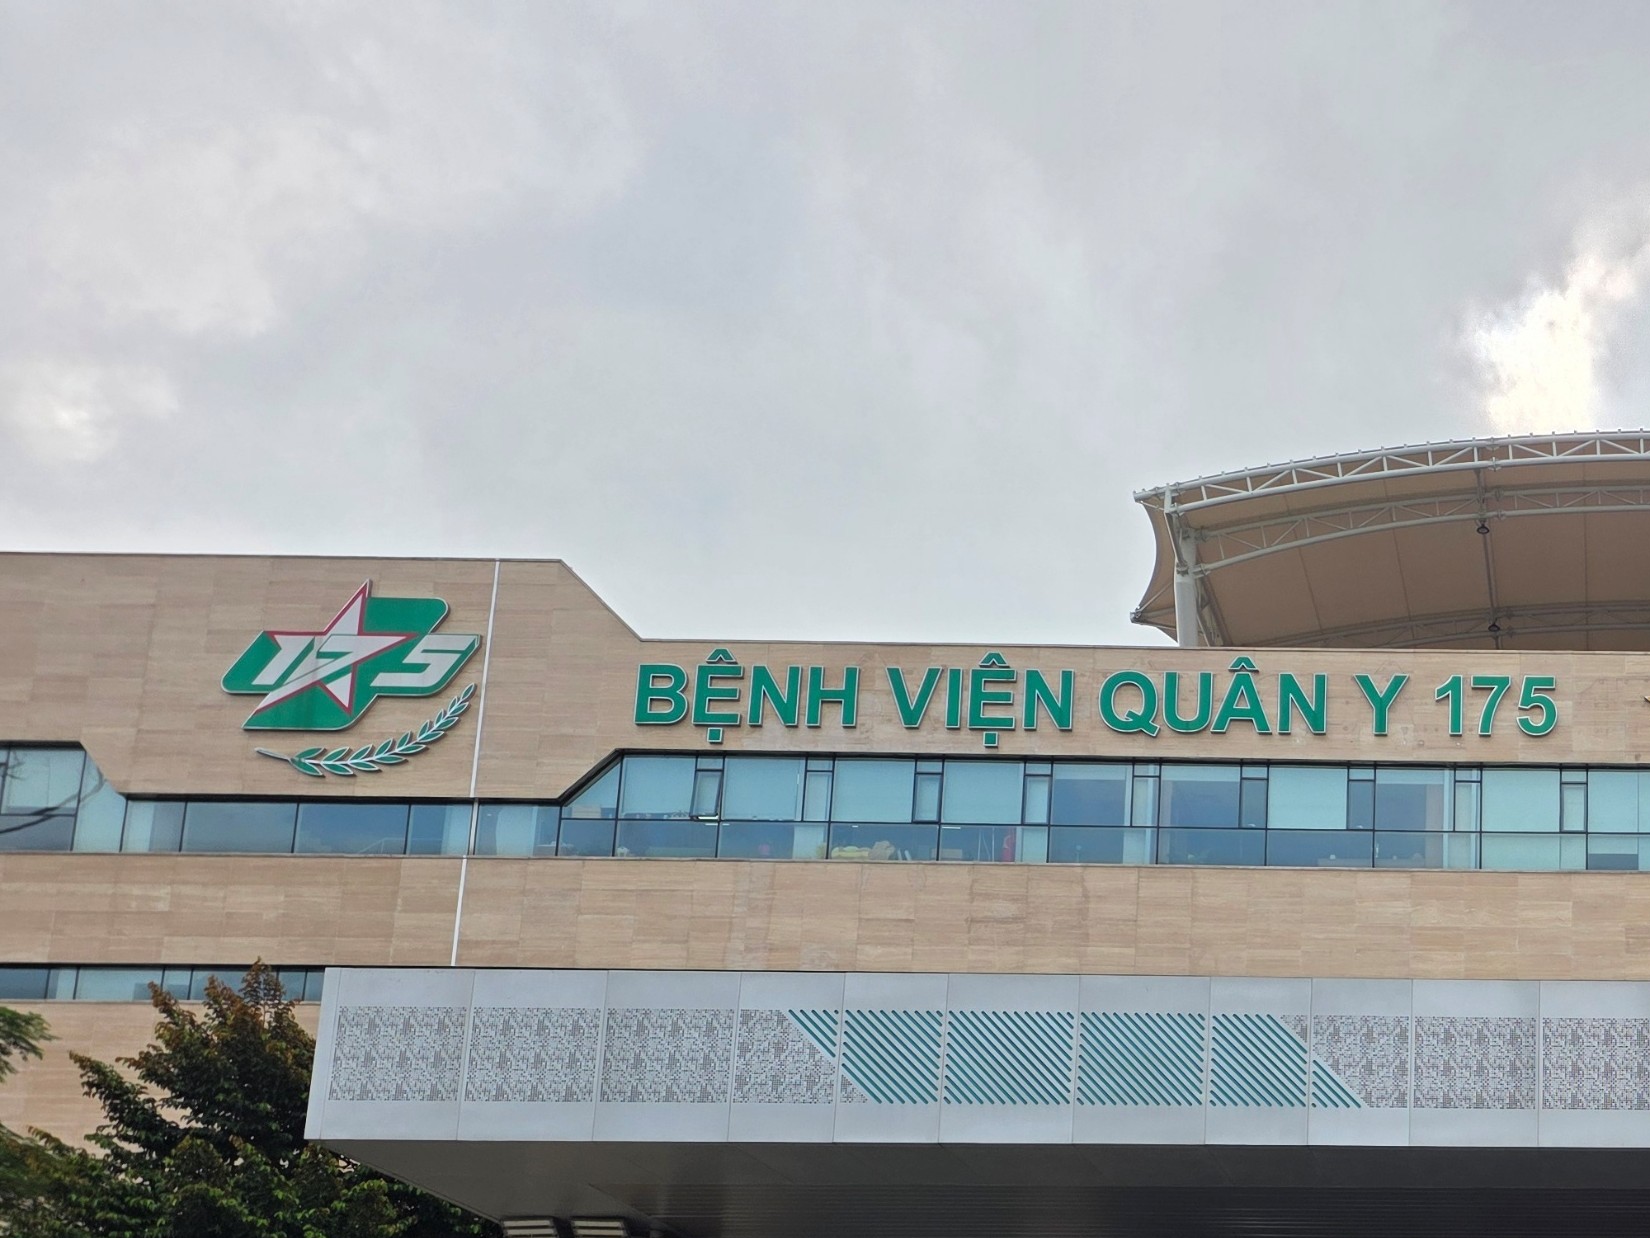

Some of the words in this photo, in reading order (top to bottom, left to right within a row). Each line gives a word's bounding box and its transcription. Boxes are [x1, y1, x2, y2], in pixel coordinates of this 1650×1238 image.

[633, 647, 860, 743] BỆNH
[886, 651, 1075, 747] VIỆN
[1098, 655, 1328, 735] QUÂN
[1355, 673, 1407, 735] Y
[1435, 674, 1558, 736] 175
